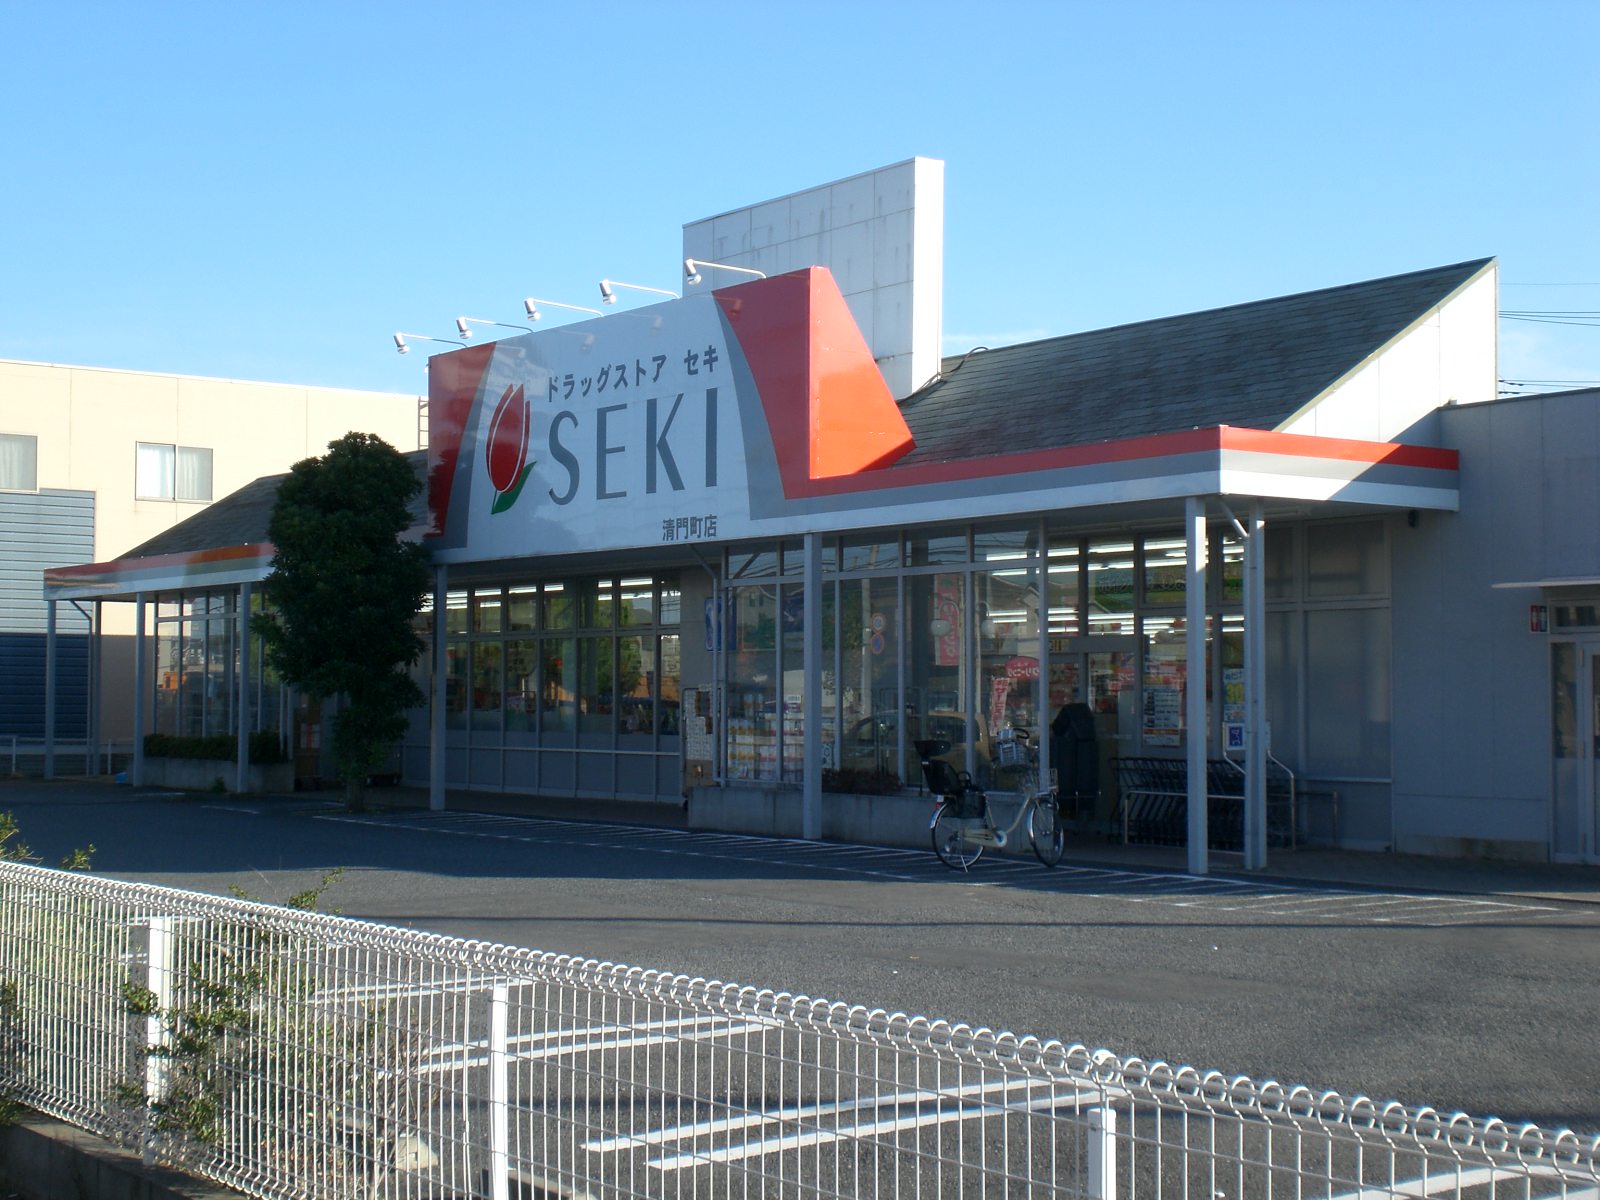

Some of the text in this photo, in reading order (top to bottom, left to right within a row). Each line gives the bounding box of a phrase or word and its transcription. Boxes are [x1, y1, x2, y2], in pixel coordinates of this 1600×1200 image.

[548, 345, 719, 403] ドラッグストア セキ
[549, 387, 718, 506] SEKI
[662, 514, 718, 542] 清門町店
